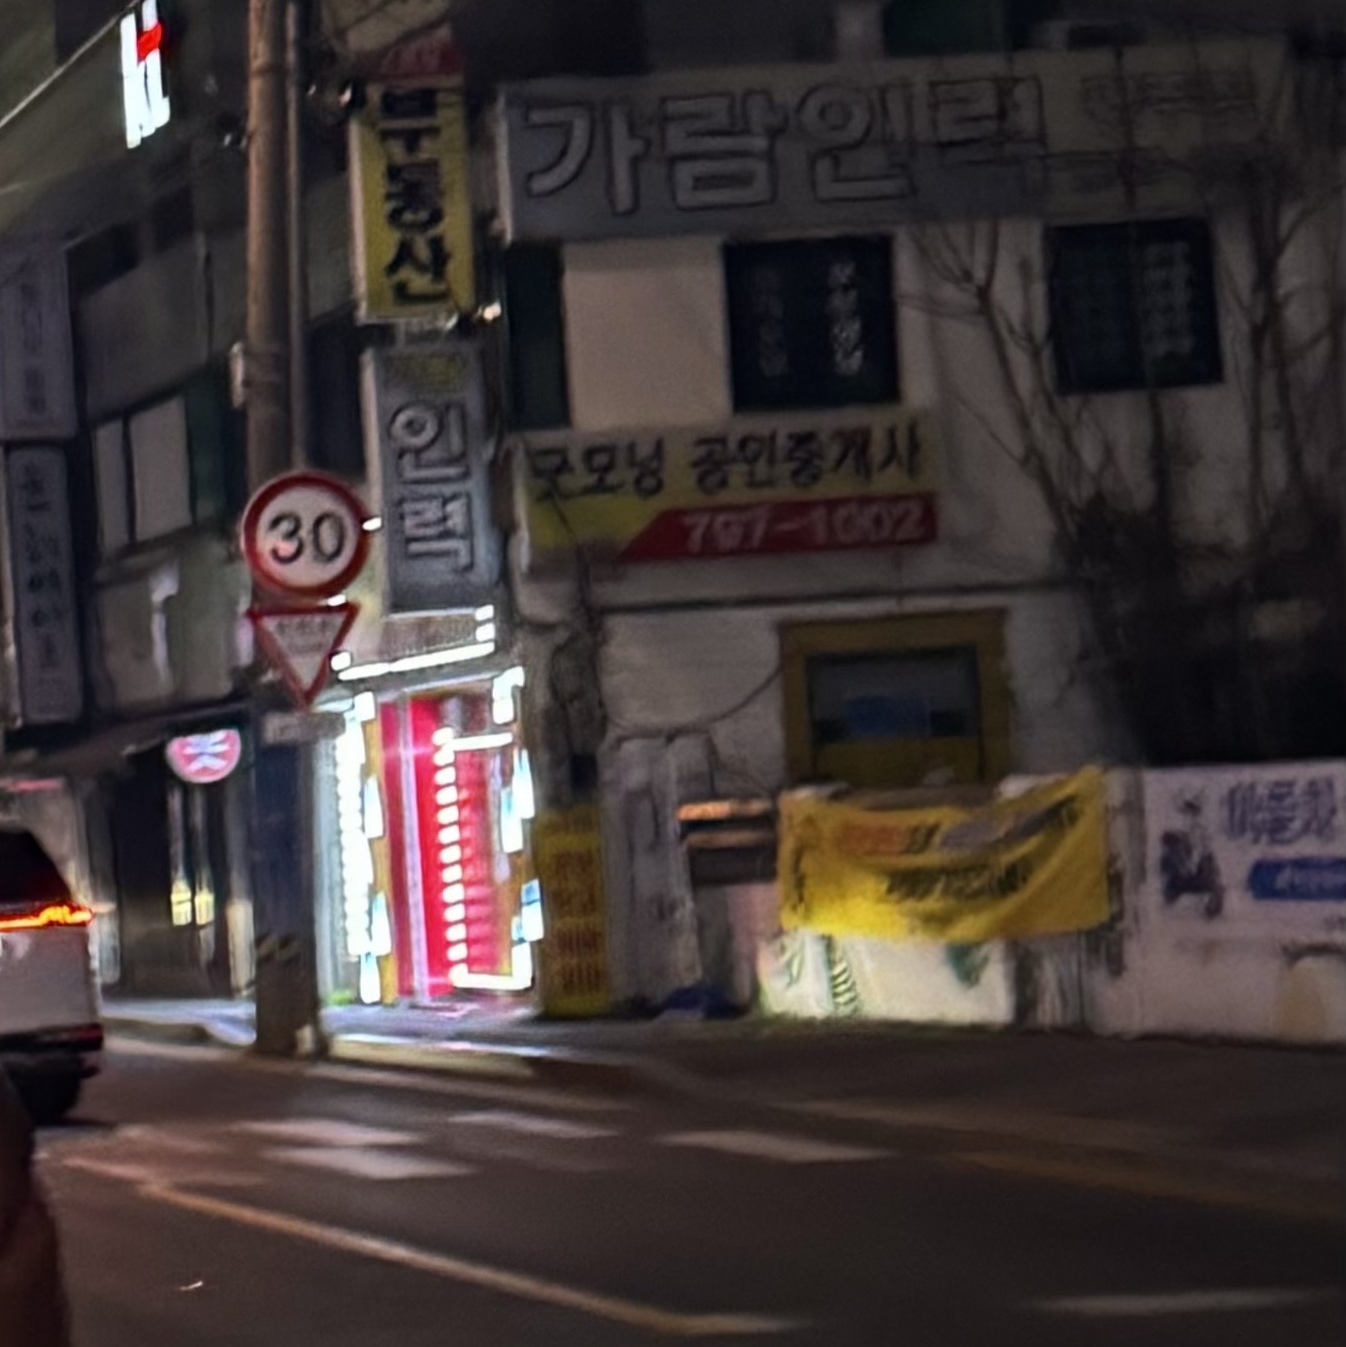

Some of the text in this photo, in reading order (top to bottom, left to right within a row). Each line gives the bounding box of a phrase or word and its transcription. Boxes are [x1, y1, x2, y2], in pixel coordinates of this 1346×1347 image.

[379, 89, 449, 306] 부동산
[524, 73, 1046, 218] 가람인력
[389, 401, 476, 573] 인력
[692, 422, 920, 495] 공인중개사
[265, 510, 346, 566] 30
